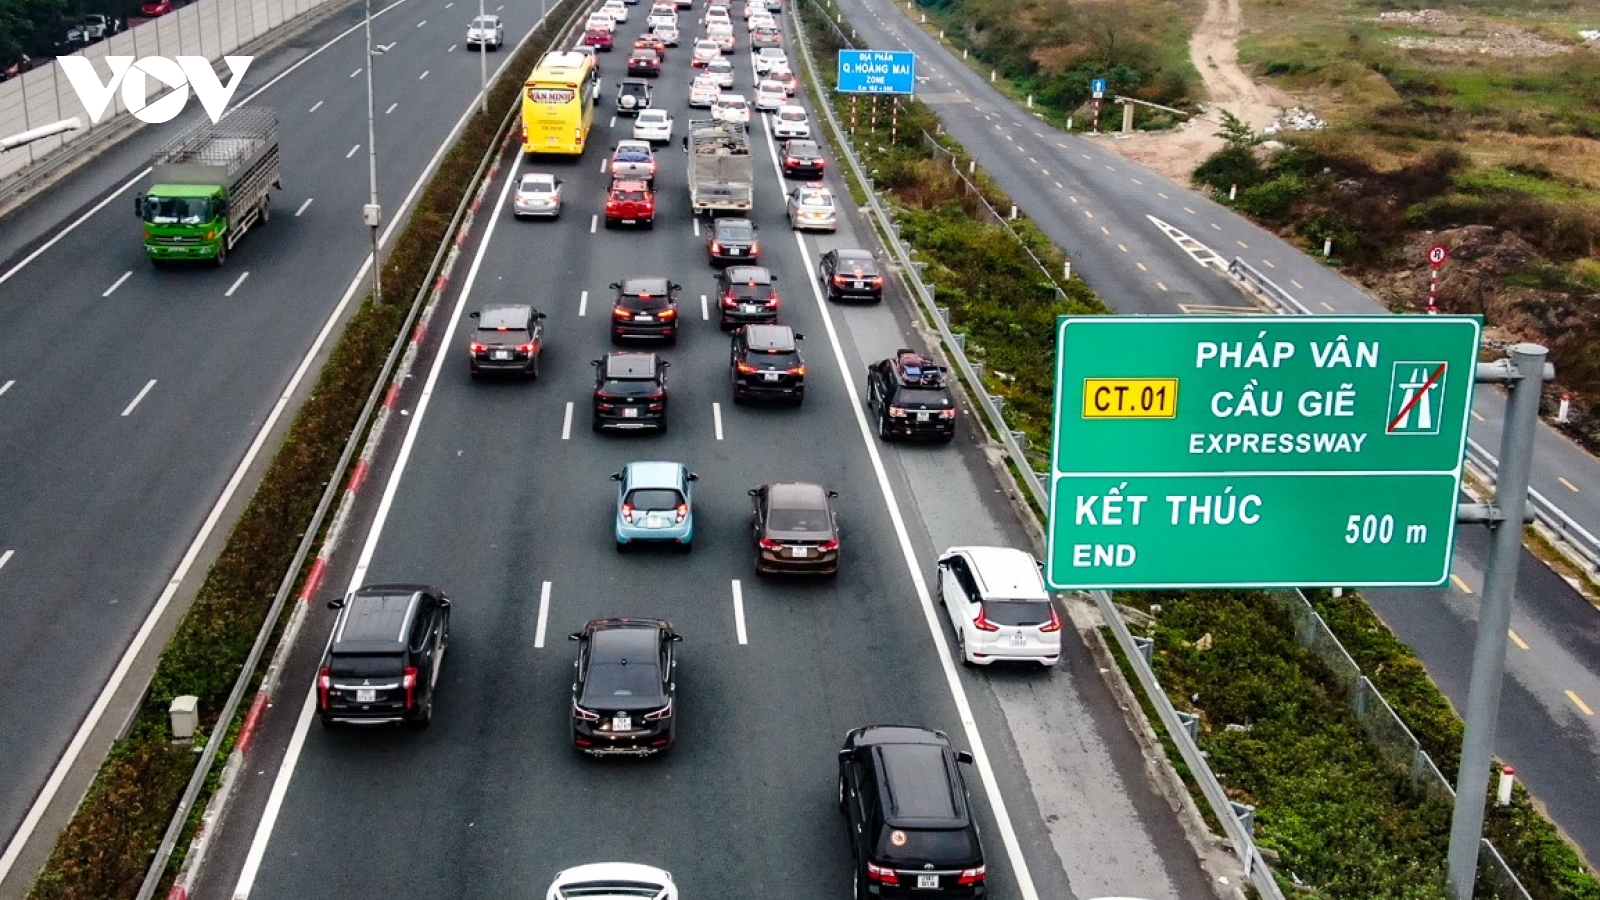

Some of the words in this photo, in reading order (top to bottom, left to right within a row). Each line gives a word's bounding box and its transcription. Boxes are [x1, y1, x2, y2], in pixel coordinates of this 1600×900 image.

[866, 75, 885, 84] ZONE
[892, 64, 910, 75] MAI
[1196, 331, 1295, 368] PHÁP
[1310, 335, 1379, 368] VÂN
[1094, 386, 1166, 411] CT.01
[1211, 379, 1283, 417] CẦU
[1298, 383, 1356, 417] GIẼ
[1189, 433, 1367, 453] EXPRESSWAY
[1075, 482, 1148, 525] KẾT
[1165, 486, 1263, 525] THÚC
[1345, 514, 1394, 544] 500
[1405, 524, 1427, 544] m
[1073, 544, 1137, 567] END
